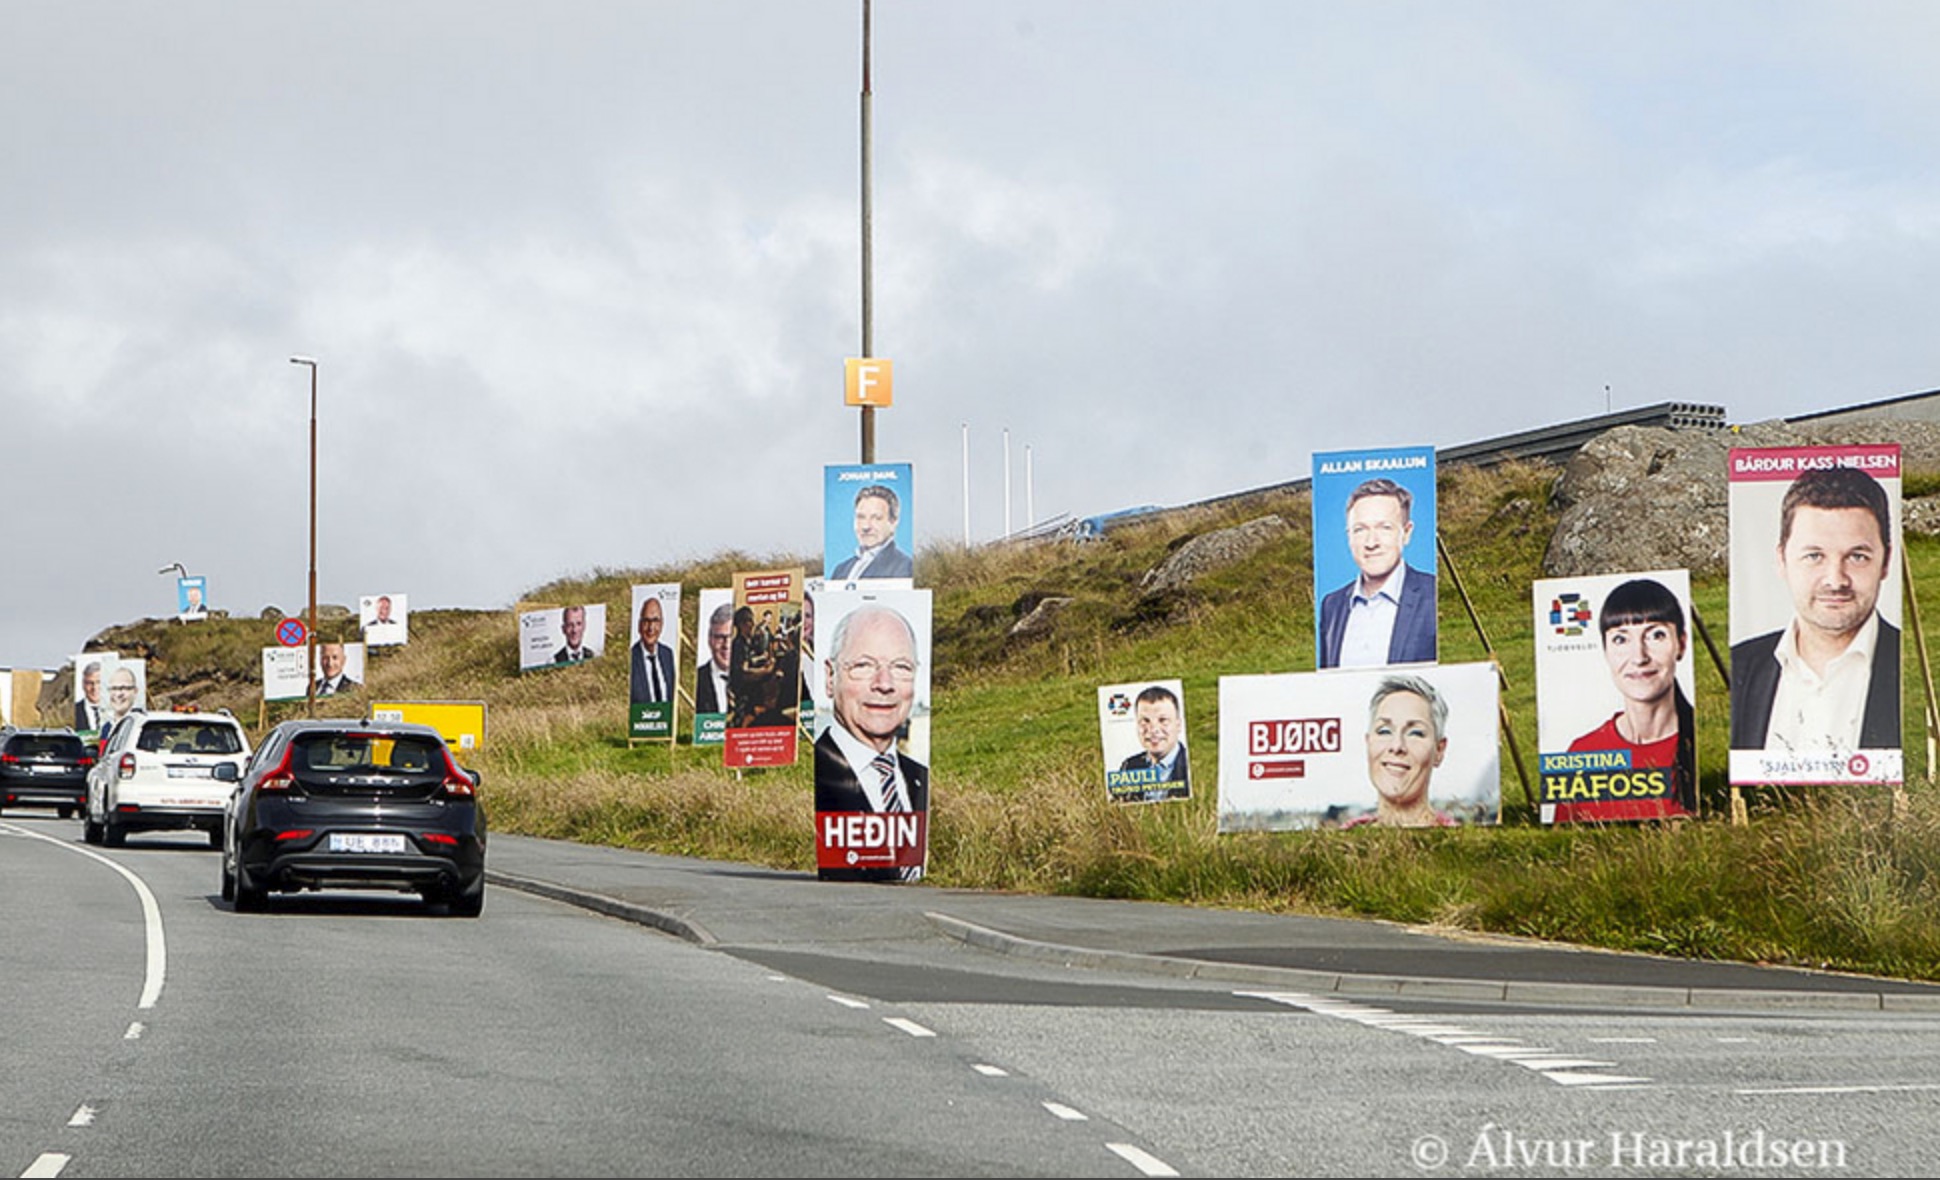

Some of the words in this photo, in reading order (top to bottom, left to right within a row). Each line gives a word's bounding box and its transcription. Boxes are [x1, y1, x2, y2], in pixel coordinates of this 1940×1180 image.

[858, 366, 879, 399] F
[1320, 461, 1363, 475] ALLAN
[1797, 455, 1835, 471] KASS
[1836, 453, 1898, 470] NIELSEN
[1252, 719, 1339, 753] BJØRG
[1544, 752, 1628, 771] KRISTINA
[1110, 768, 1157, 785] PAULI
[1545, 769, 1666, 800] HÁFOSS
[824, 814, 918, 848] HEÐIN
